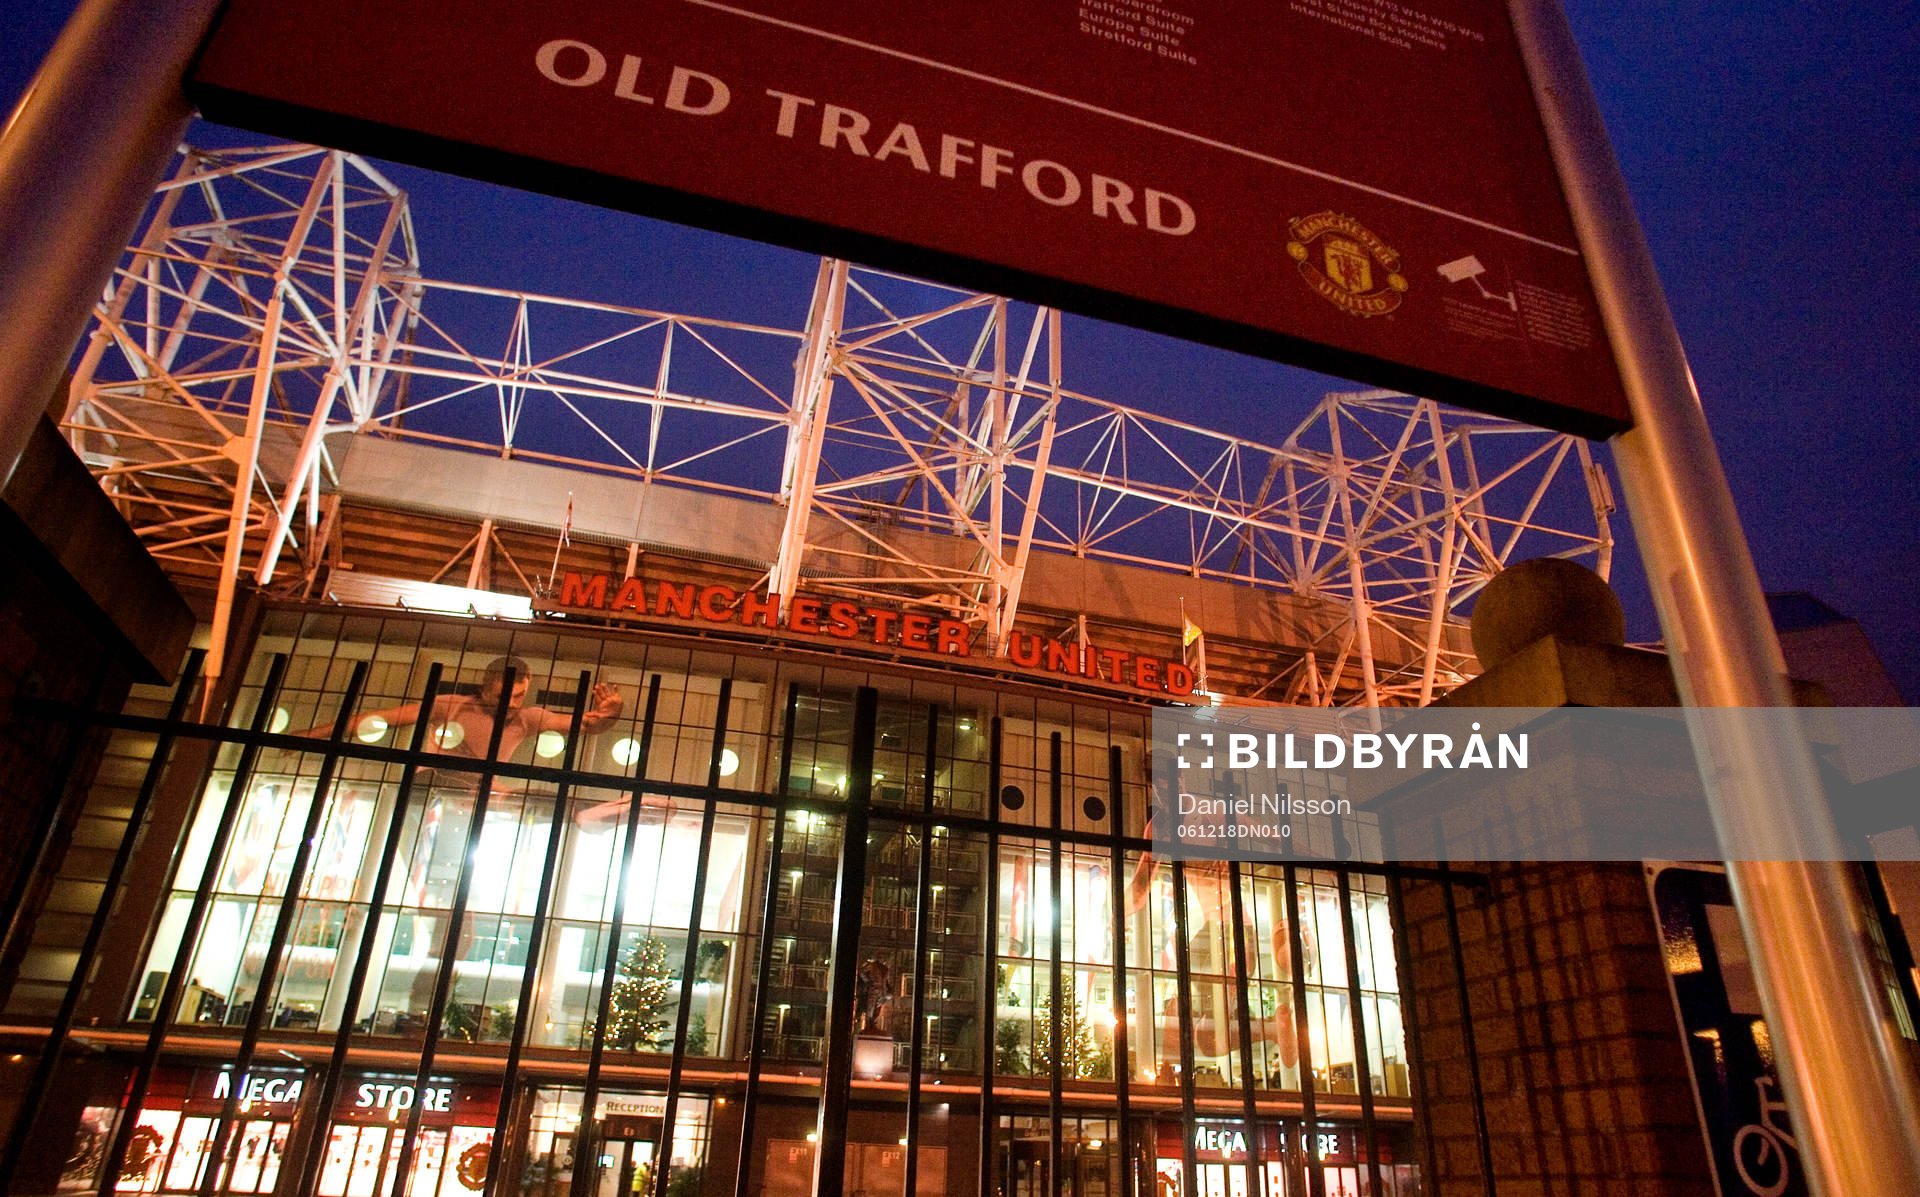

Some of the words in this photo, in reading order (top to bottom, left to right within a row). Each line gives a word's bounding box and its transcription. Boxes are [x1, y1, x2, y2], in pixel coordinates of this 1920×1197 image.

[1079, 7, 1135, 33] Europa
[1139, 25, 1180, 47] Suite
[1121, 0, 1195, 26] oardroom
[1146, 14, 1186, 36] Suite
[1289, 2, 1376, 37] International
[1377, 30, 1412, 50] Suite
[1079, 21, 1152, 52] Stretford
[1157, 44, 1198, 66] Suite
[535, 39, 731, 117] OLD
[766, 89, 1197, 237] TRAFFORD
[1318, 279, 1388, 312] UNITED
[559, 571, 970, 657] MANCHESTER
[1010, 629, 1194, 696] UNITED
[355, 1083, 452, 1112] STORE
[606, 1101, 664, 1114] RECEPTION
